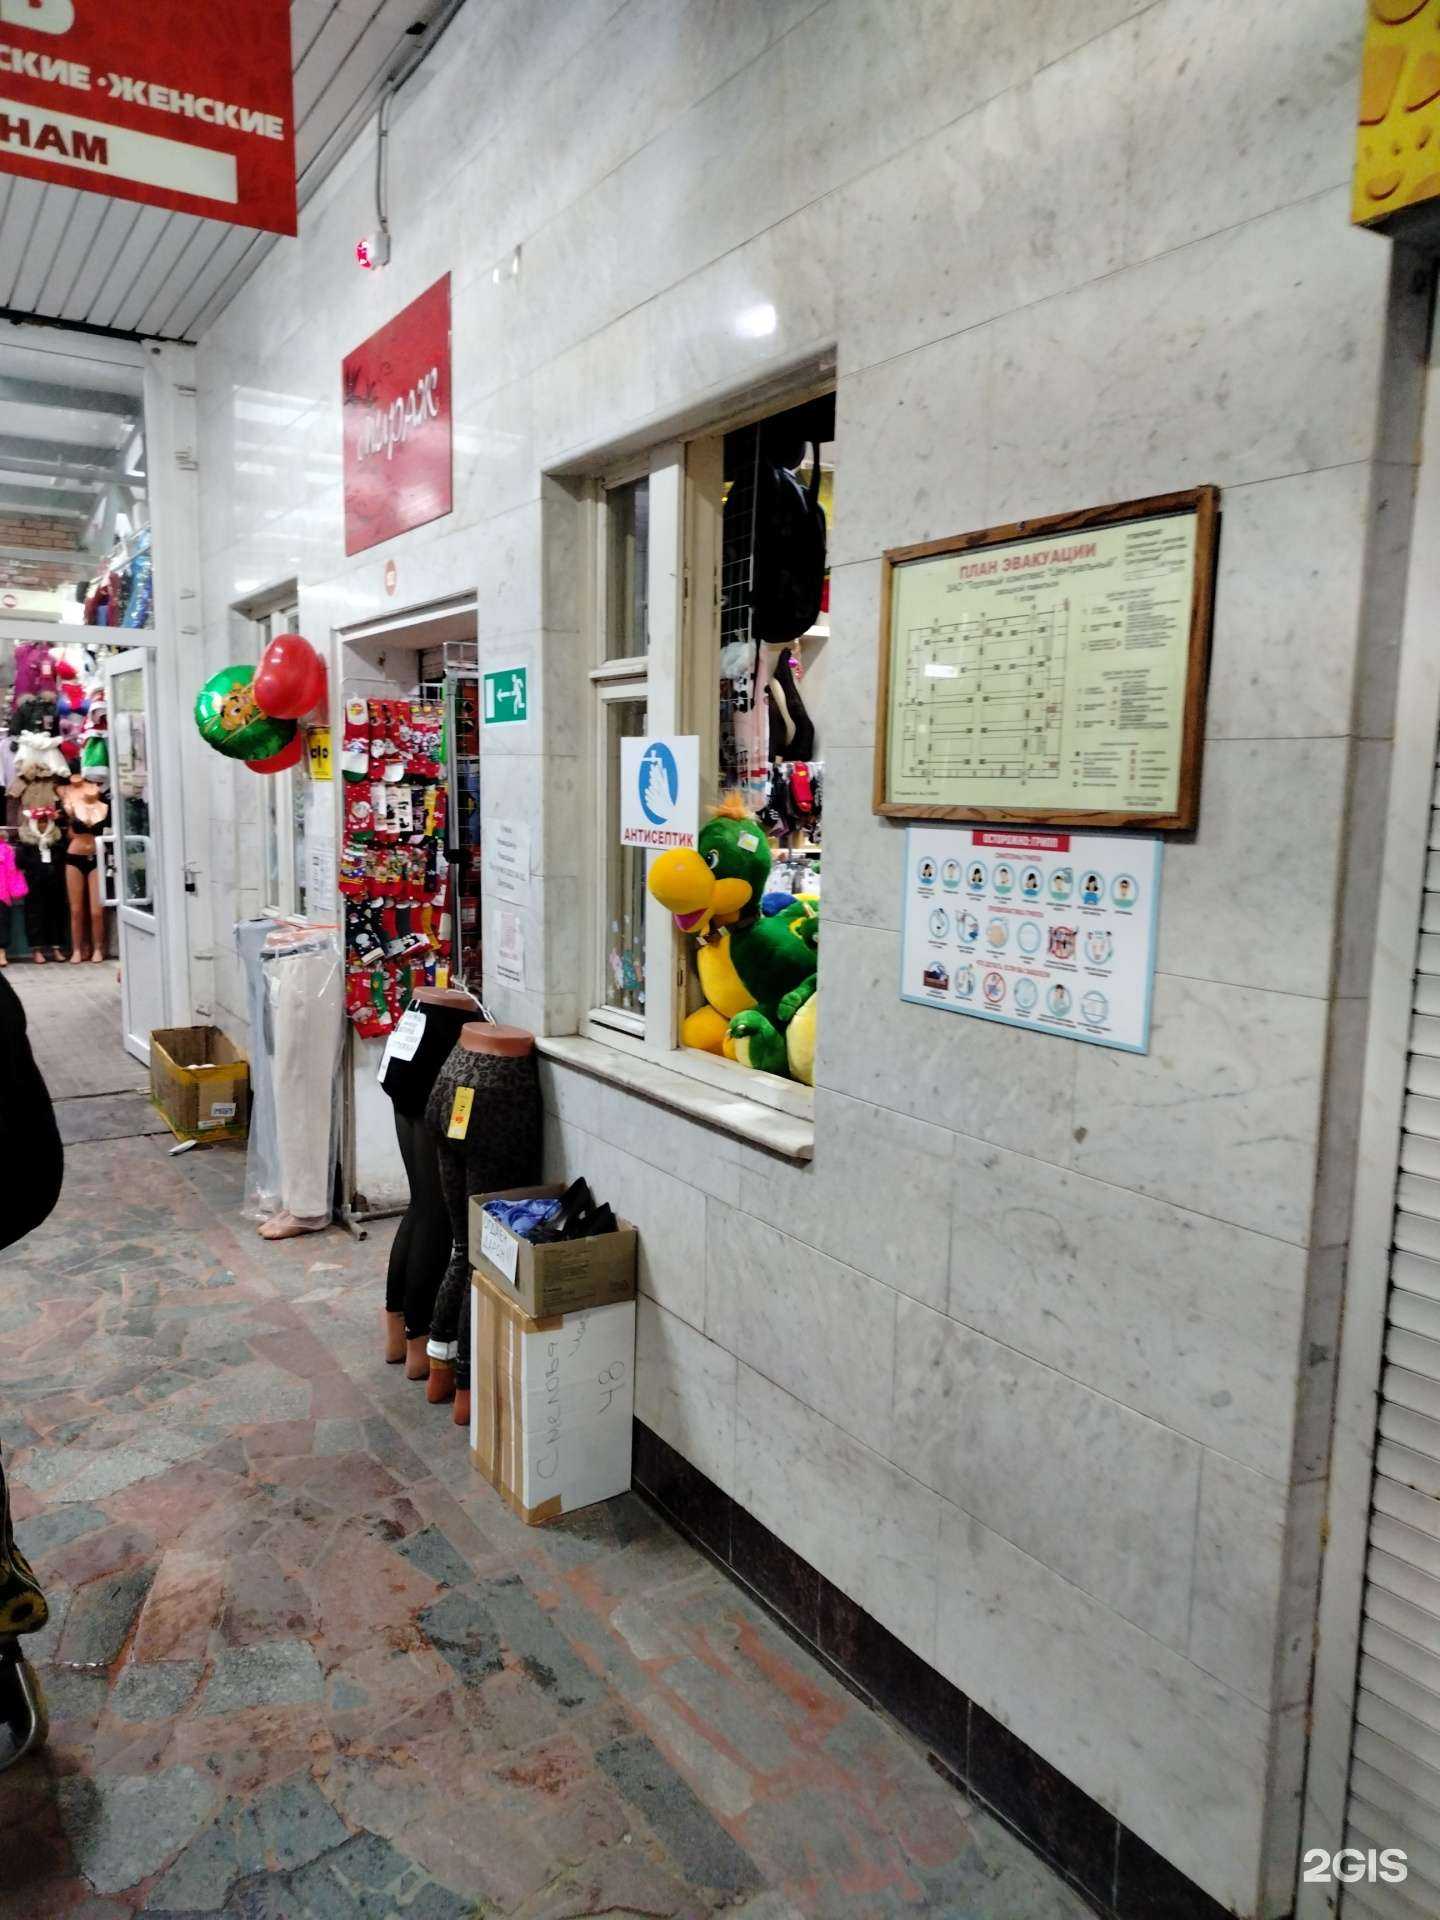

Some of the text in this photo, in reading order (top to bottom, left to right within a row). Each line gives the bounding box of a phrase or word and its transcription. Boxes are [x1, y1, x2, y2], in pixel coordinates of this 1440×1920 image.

[106, 72, 284, 141] ЖЕНСКИЕ
[959, 560, 999, 580] ПЛАН
[1001, 542, 1097, 572] ЭВАКУАЦИИ
[623, 827, 694, 846] АНТИСЕПТИК
